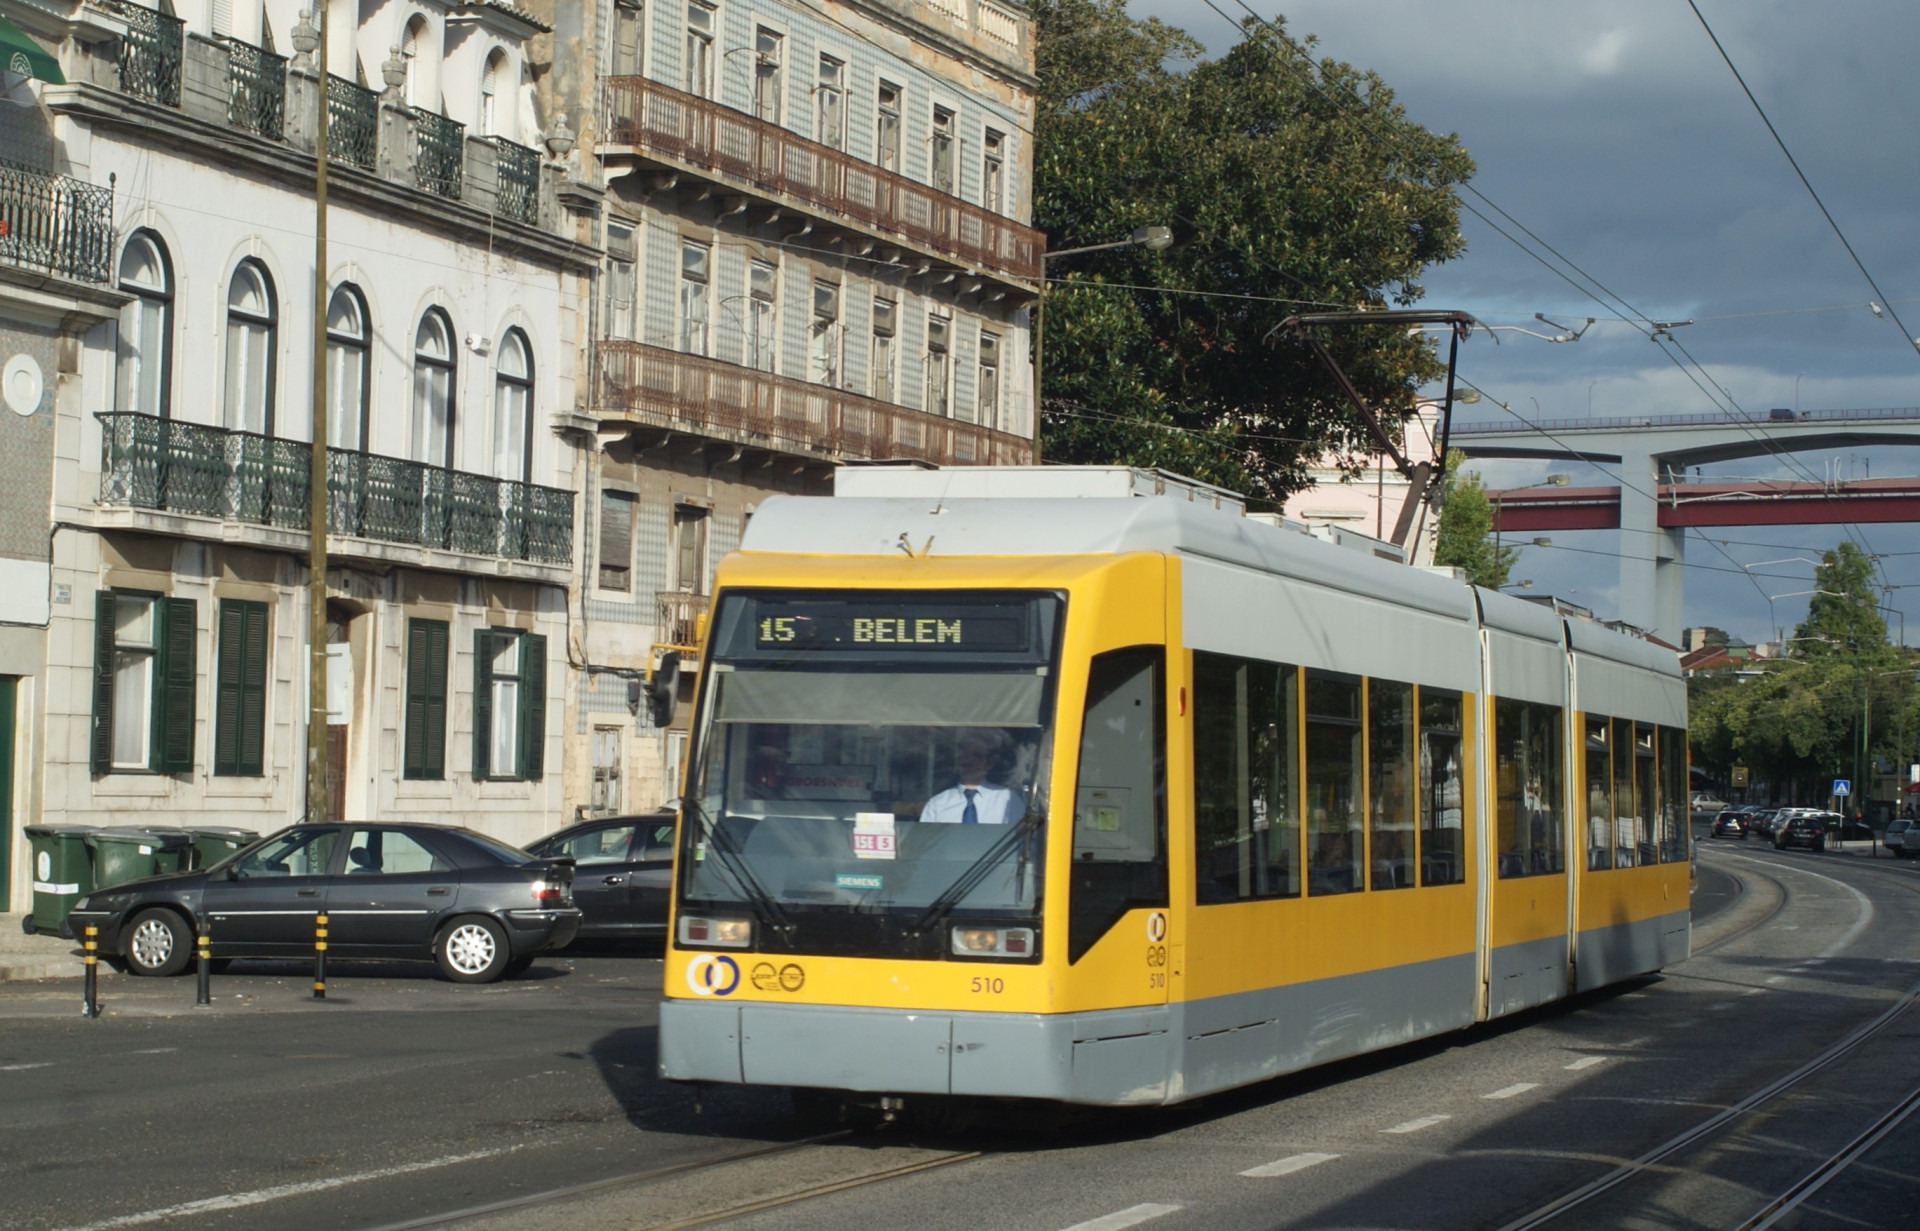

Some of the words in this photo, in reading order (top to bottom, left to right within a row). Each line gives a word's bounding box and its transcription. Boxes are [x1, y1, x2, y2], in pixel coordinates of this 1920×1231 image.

[760, 617, 795, 641] 15
[854, 618, 961, 643] BELEM
[837, 877, 881, 887] SIEMENS
[970, 976, 1005, 994] 510
[1150, 972, 1165, 988] 510
